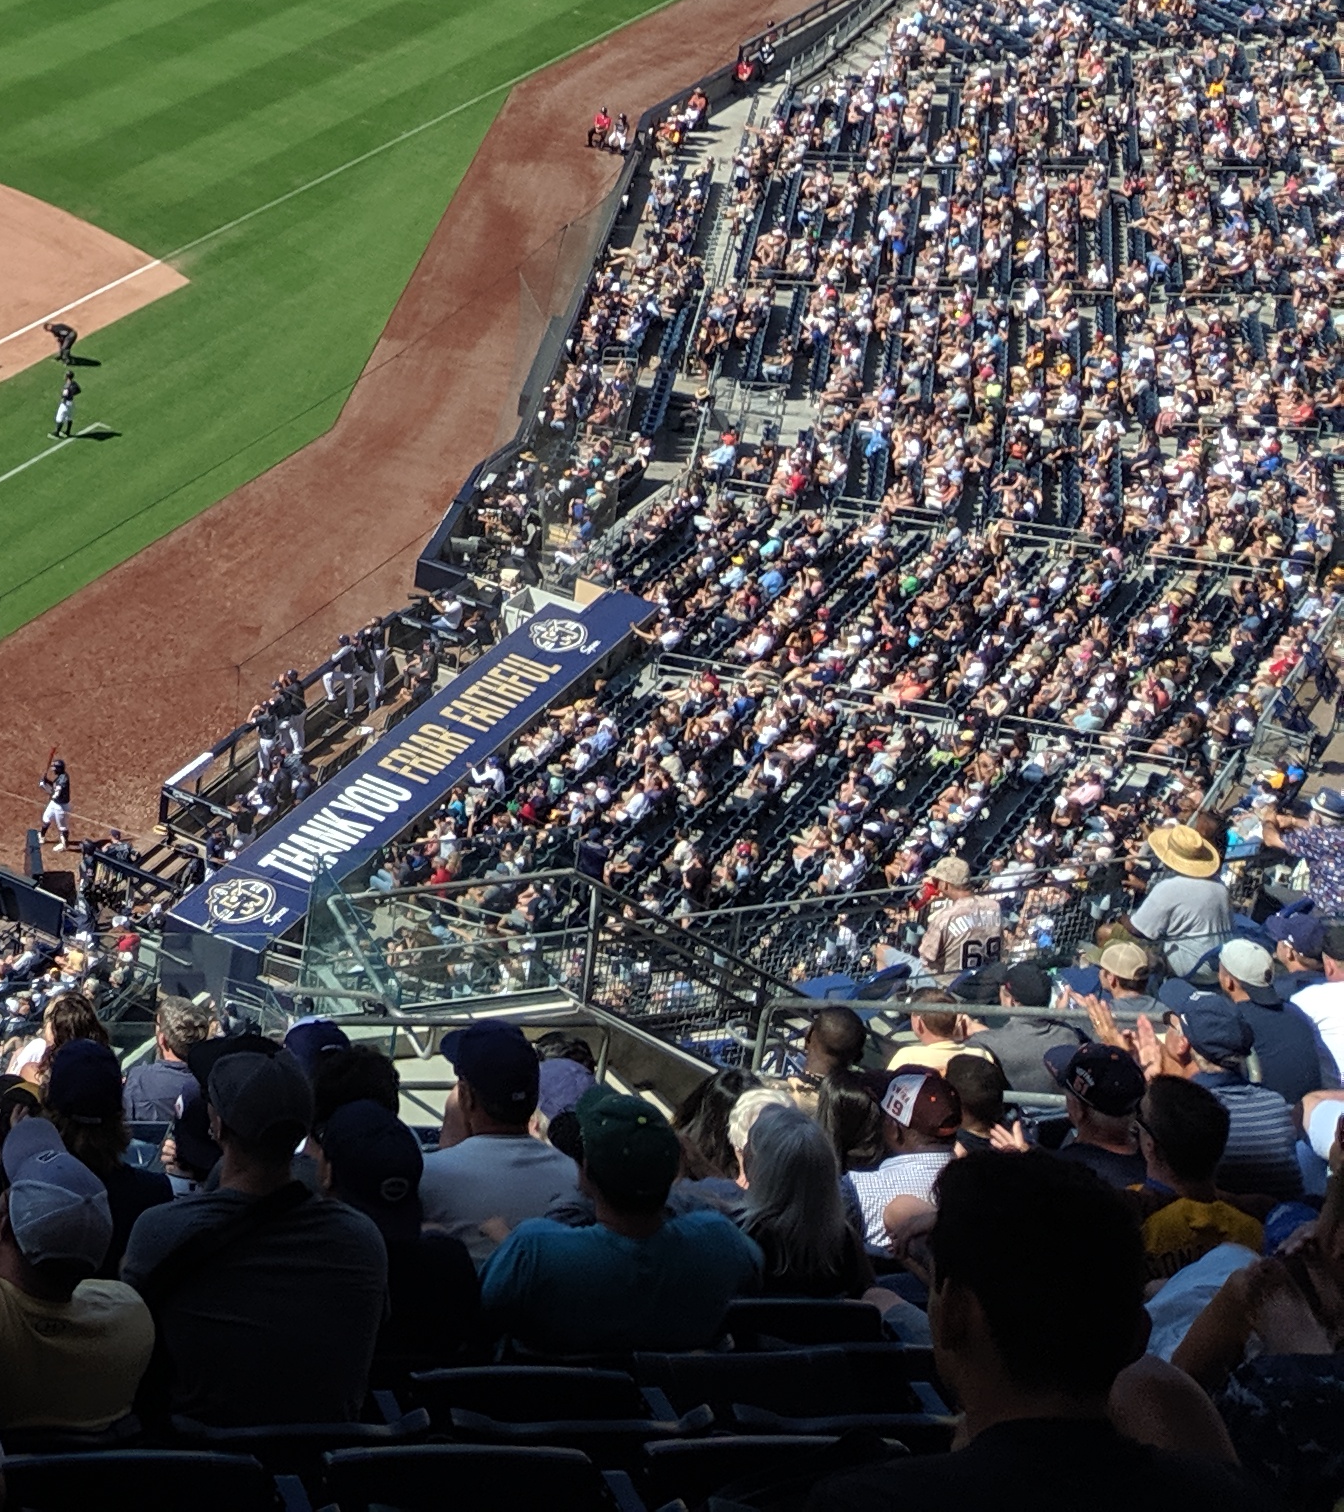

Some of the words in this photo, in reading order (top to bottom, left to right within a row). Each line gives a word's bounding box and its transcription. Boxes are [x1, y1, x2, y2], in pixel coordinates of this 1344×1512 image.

[258, 784, 375, 883] THANK
[341, 773, 414, 824] YOU
[378, 722, 477, 785] FRIAR
[439, 653, 563, 734] FAITHFUL
